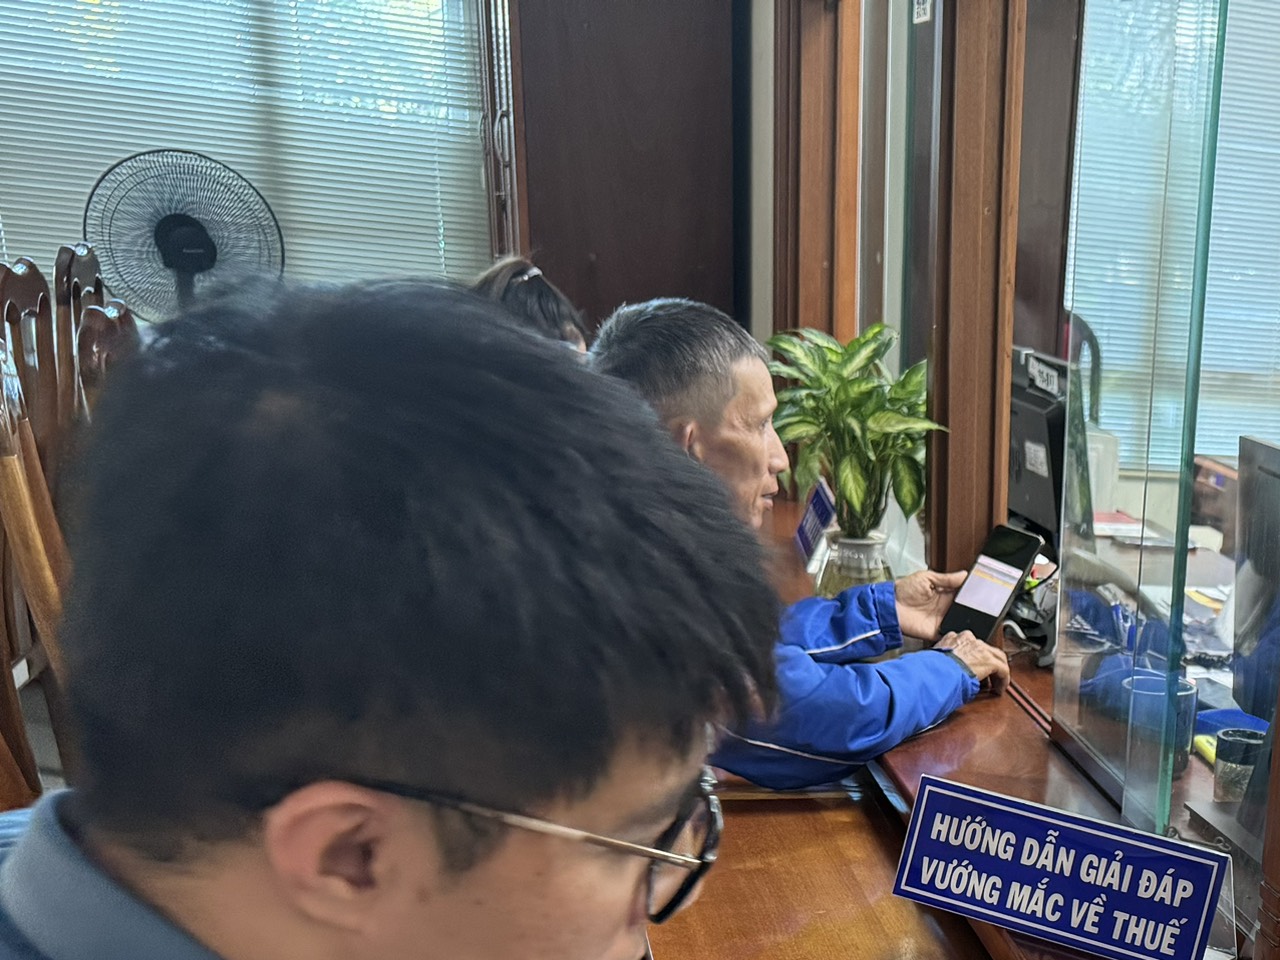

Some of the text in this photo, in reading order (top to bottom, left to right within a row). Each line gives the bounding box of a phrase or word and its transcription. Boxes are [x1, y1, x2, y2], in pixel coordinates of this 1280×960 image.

[920, 856, 1189, 956] VƯỚNG MẮC VỀ THUẾ
[930, 812, 1195, 908] HƯỚNG DẪN GIẢI ĐÁP
